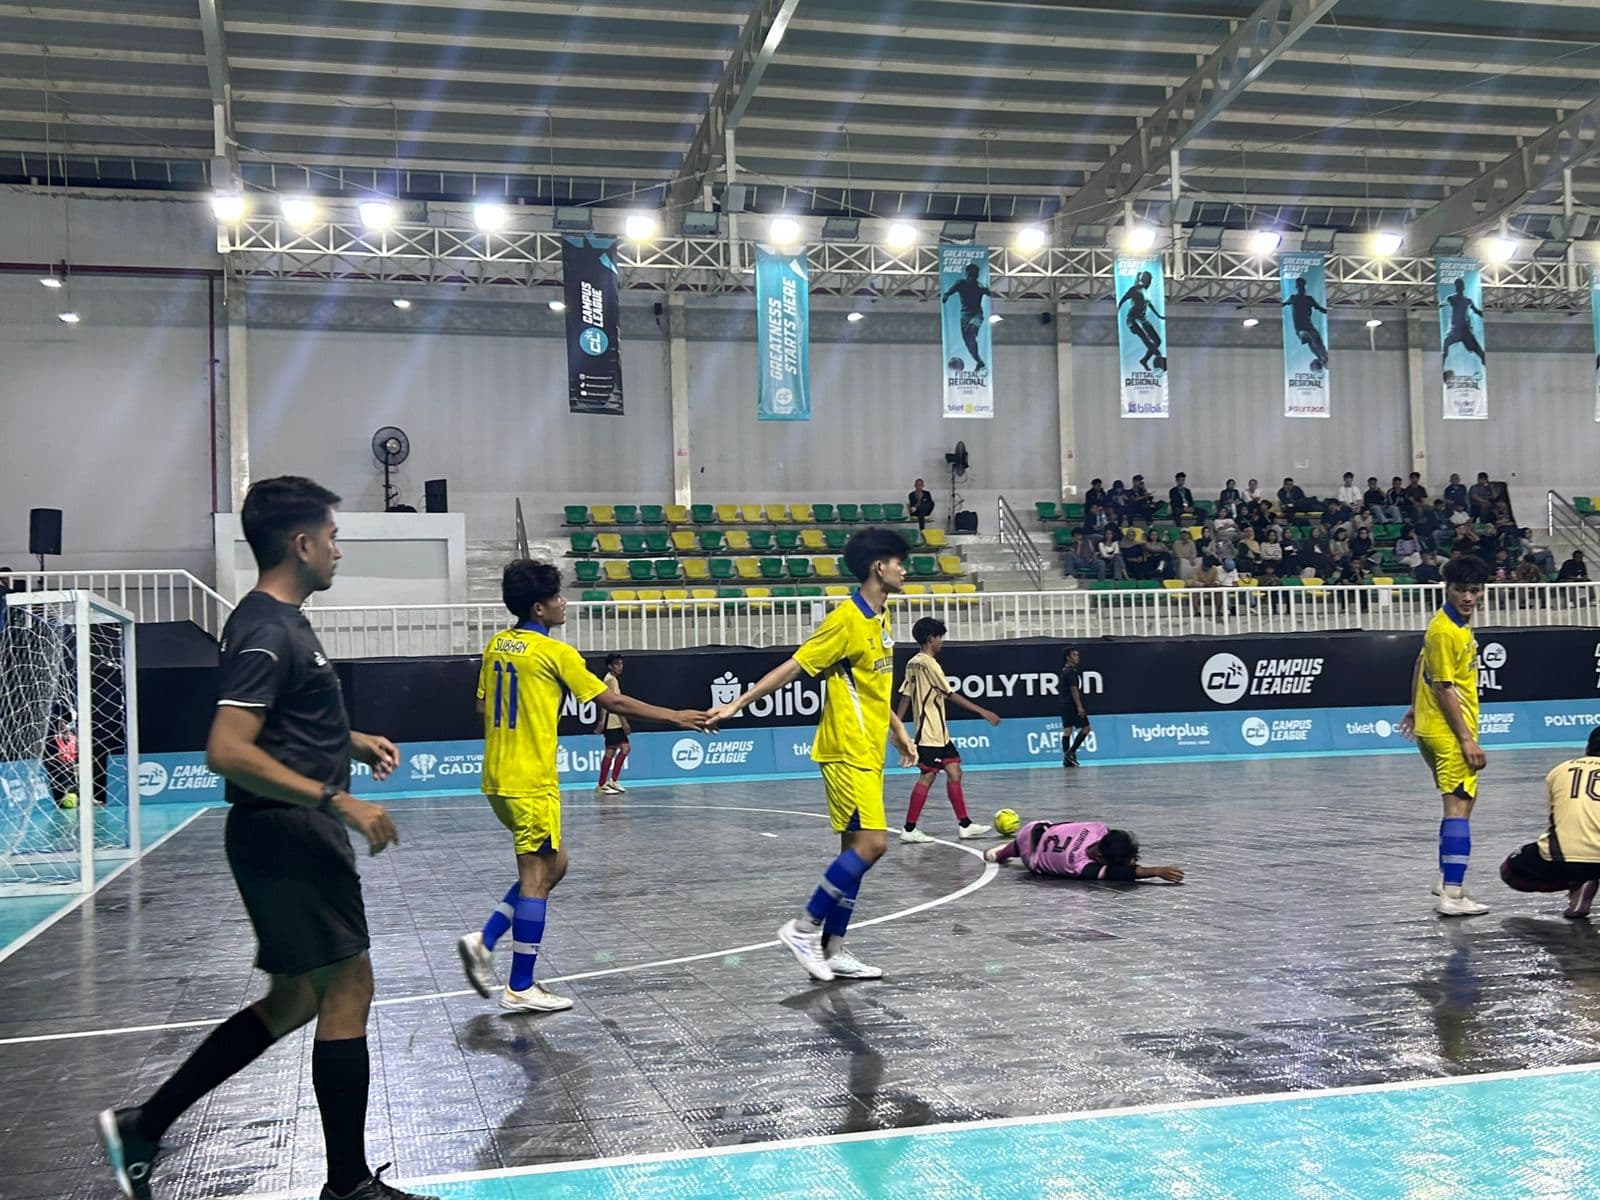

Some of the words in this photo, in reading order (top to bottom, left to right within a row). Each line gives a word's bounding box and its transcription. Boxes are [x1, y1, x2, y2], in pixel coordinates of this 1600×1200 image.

[581, 281, 593, 325] CAMPUS
[782, 276, 797, 316] HERE
[591, 288, 604, 328] LEAGUE
[768, 297, 783, 381] GREATNESS
[783, 318, 797, 375] STARTS
[1255, 658, 1324, 677] CAMPUS
[1207, 672, 1240, 690] CL
[1250, 676, 1315, 695] LEAGUE
[494, 661, 518, 730] 11
[1272, 720, 1313, 731] CAMPUS
[1544, 714, 1600, 727] POLYTRO
[1131, 722, 1210, 742] hydroplus
[1271, 730, 1309, 741] LEAGUE
[708, 741, 754, 753] CAMPUS
[704, 752, 749, 764] LEAGUE
[173, 764, 216, 777] CAMP
[438, 762, 483, 775] GADJ
[168, 776, 220, 790] LEAGUE
